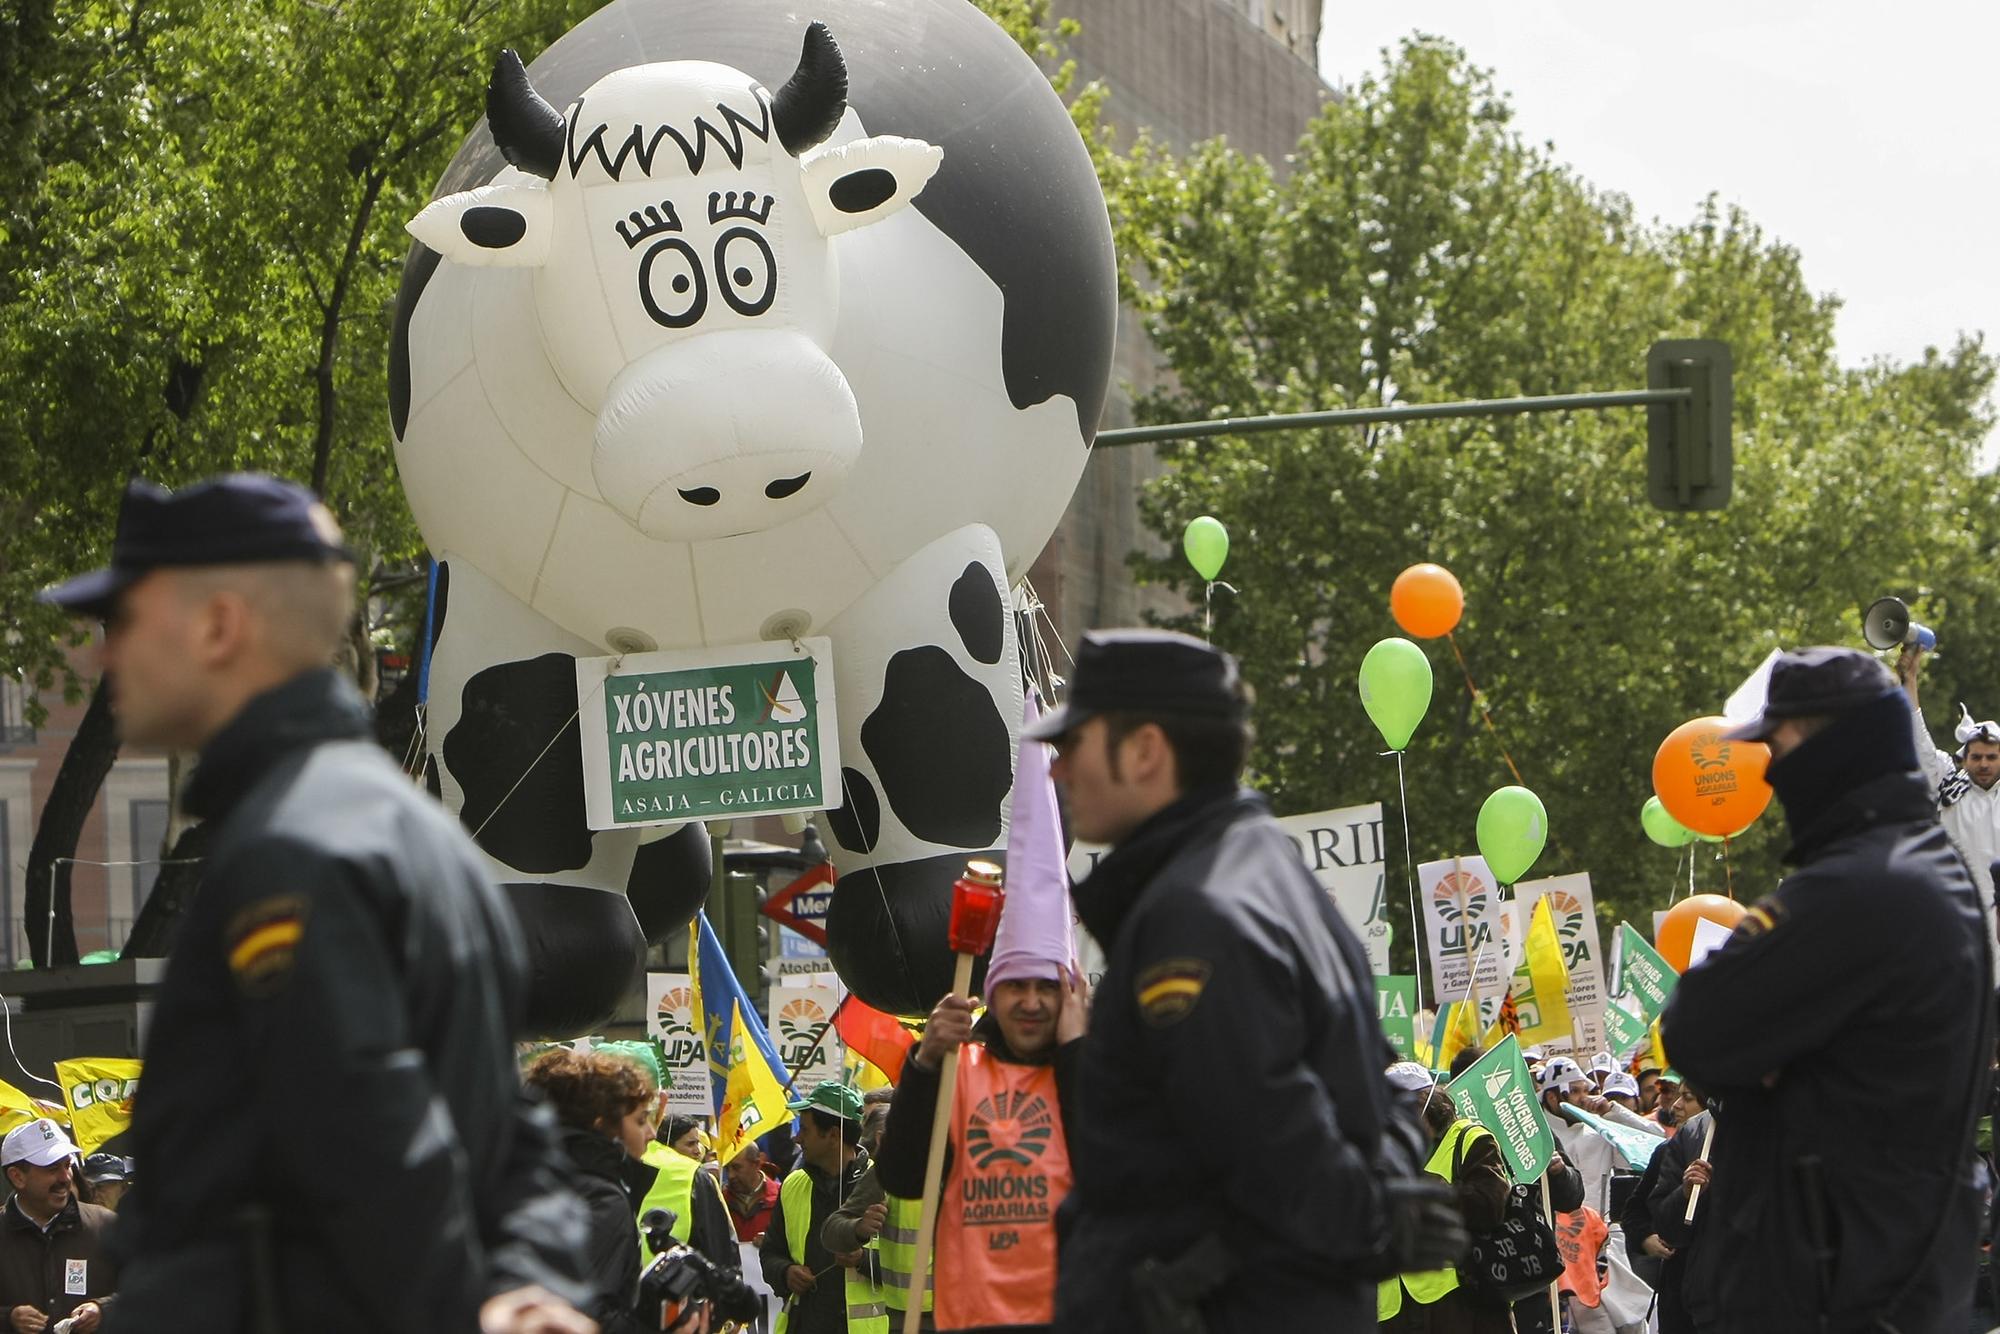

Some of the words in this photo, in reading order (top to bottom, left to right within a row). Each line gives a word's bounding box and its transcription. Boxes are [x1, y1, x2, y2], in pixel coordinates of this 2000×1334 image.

[613, 682, 736, 734] XÓVENES
[618, 728, 811, 783] AGRICULTORES
[620, 794, 691, 814] ASAJA
[719, 783, 816, 806] GALICIA
[1440, 921, 1492, 956] UPA
[779, 961, 830, 974] Atocha
[1562, 940, 1591, 970] PA
[1376, 990, 1409, 1020] JA
[660, 1040, 705, 1068] UPA
[780, 1044, 826, 1070] UPA
[1507, 1085, 1540, 1139] XÓVENES
[1492, 1098, 1537, 1171] AGRICULTORES
[963, 1169, 1049, 1201] UNIÓNS
[964, 1202, 1049, 1219] AGRARIAS
